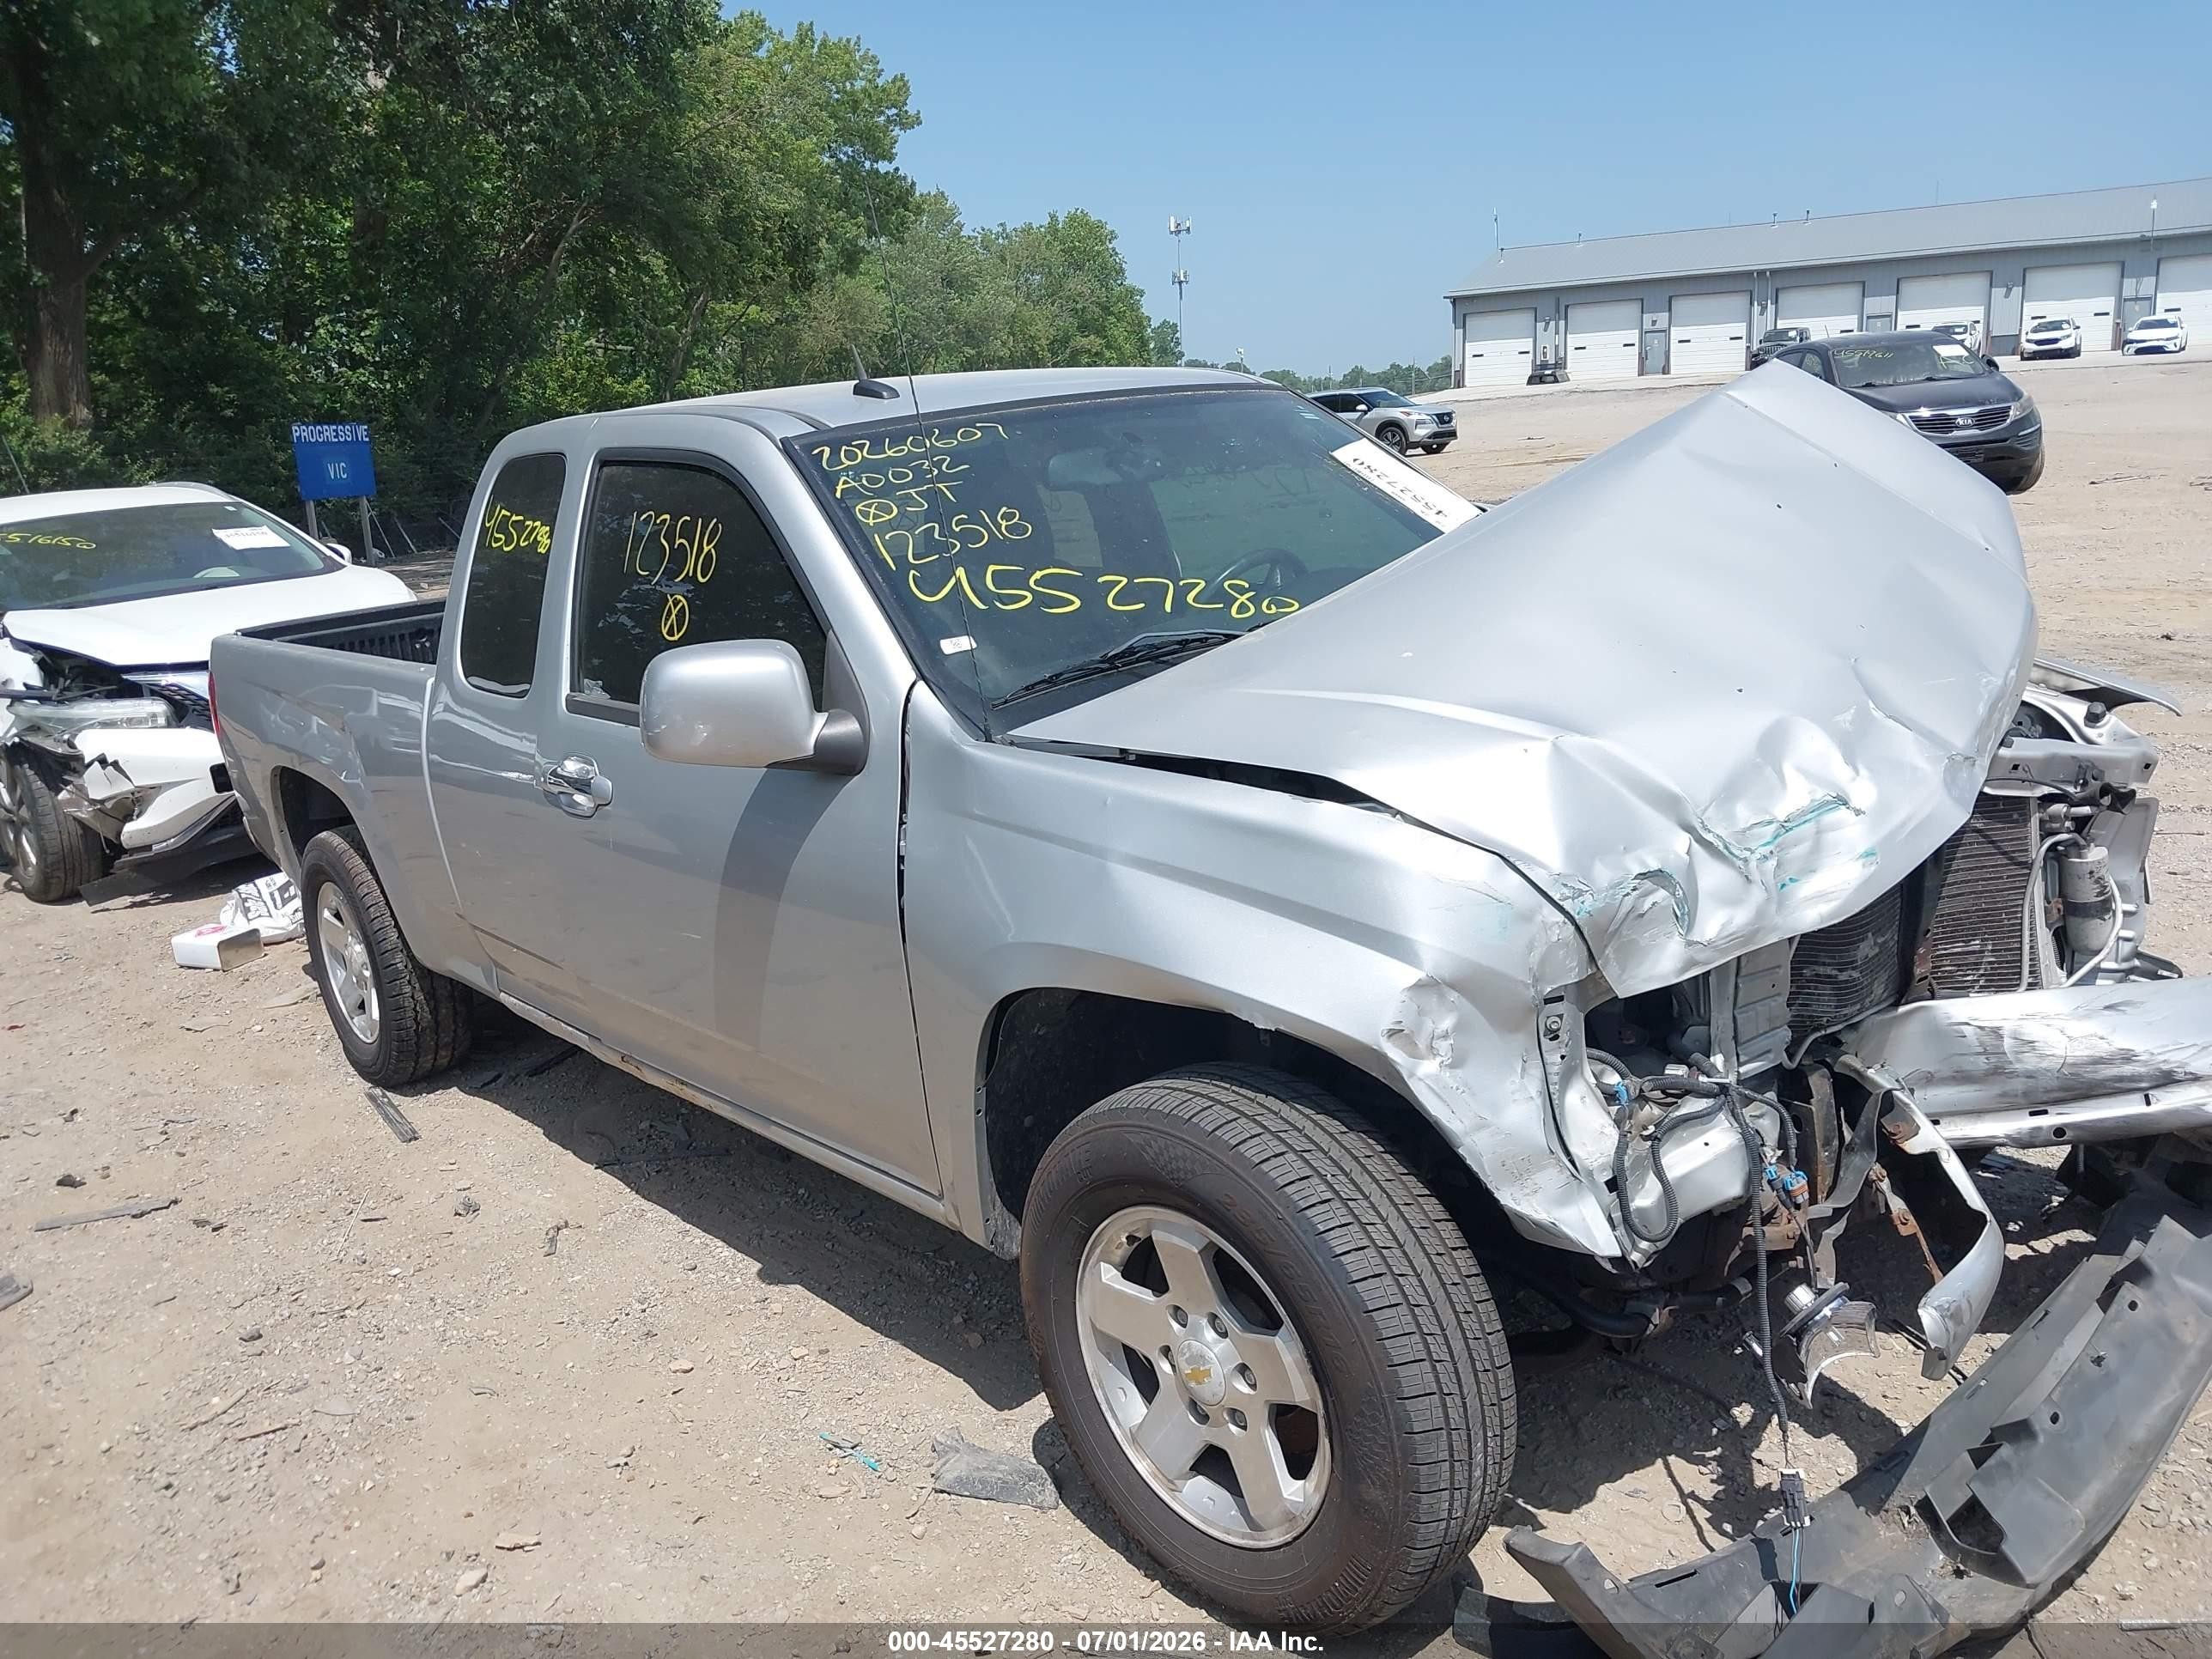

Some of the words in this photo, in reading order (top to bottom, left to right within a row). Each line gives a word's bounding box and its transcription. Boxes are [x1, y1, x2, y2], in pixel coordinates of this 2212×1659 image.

[292, 425, 369, 443] PROGRESSIVE
[327, 463, 347, 480] VIC
[623, 510, 722, 585] 123518
[873, 507, 1033, 571] 123518
[908, 563, 1301, 619] 45527280
